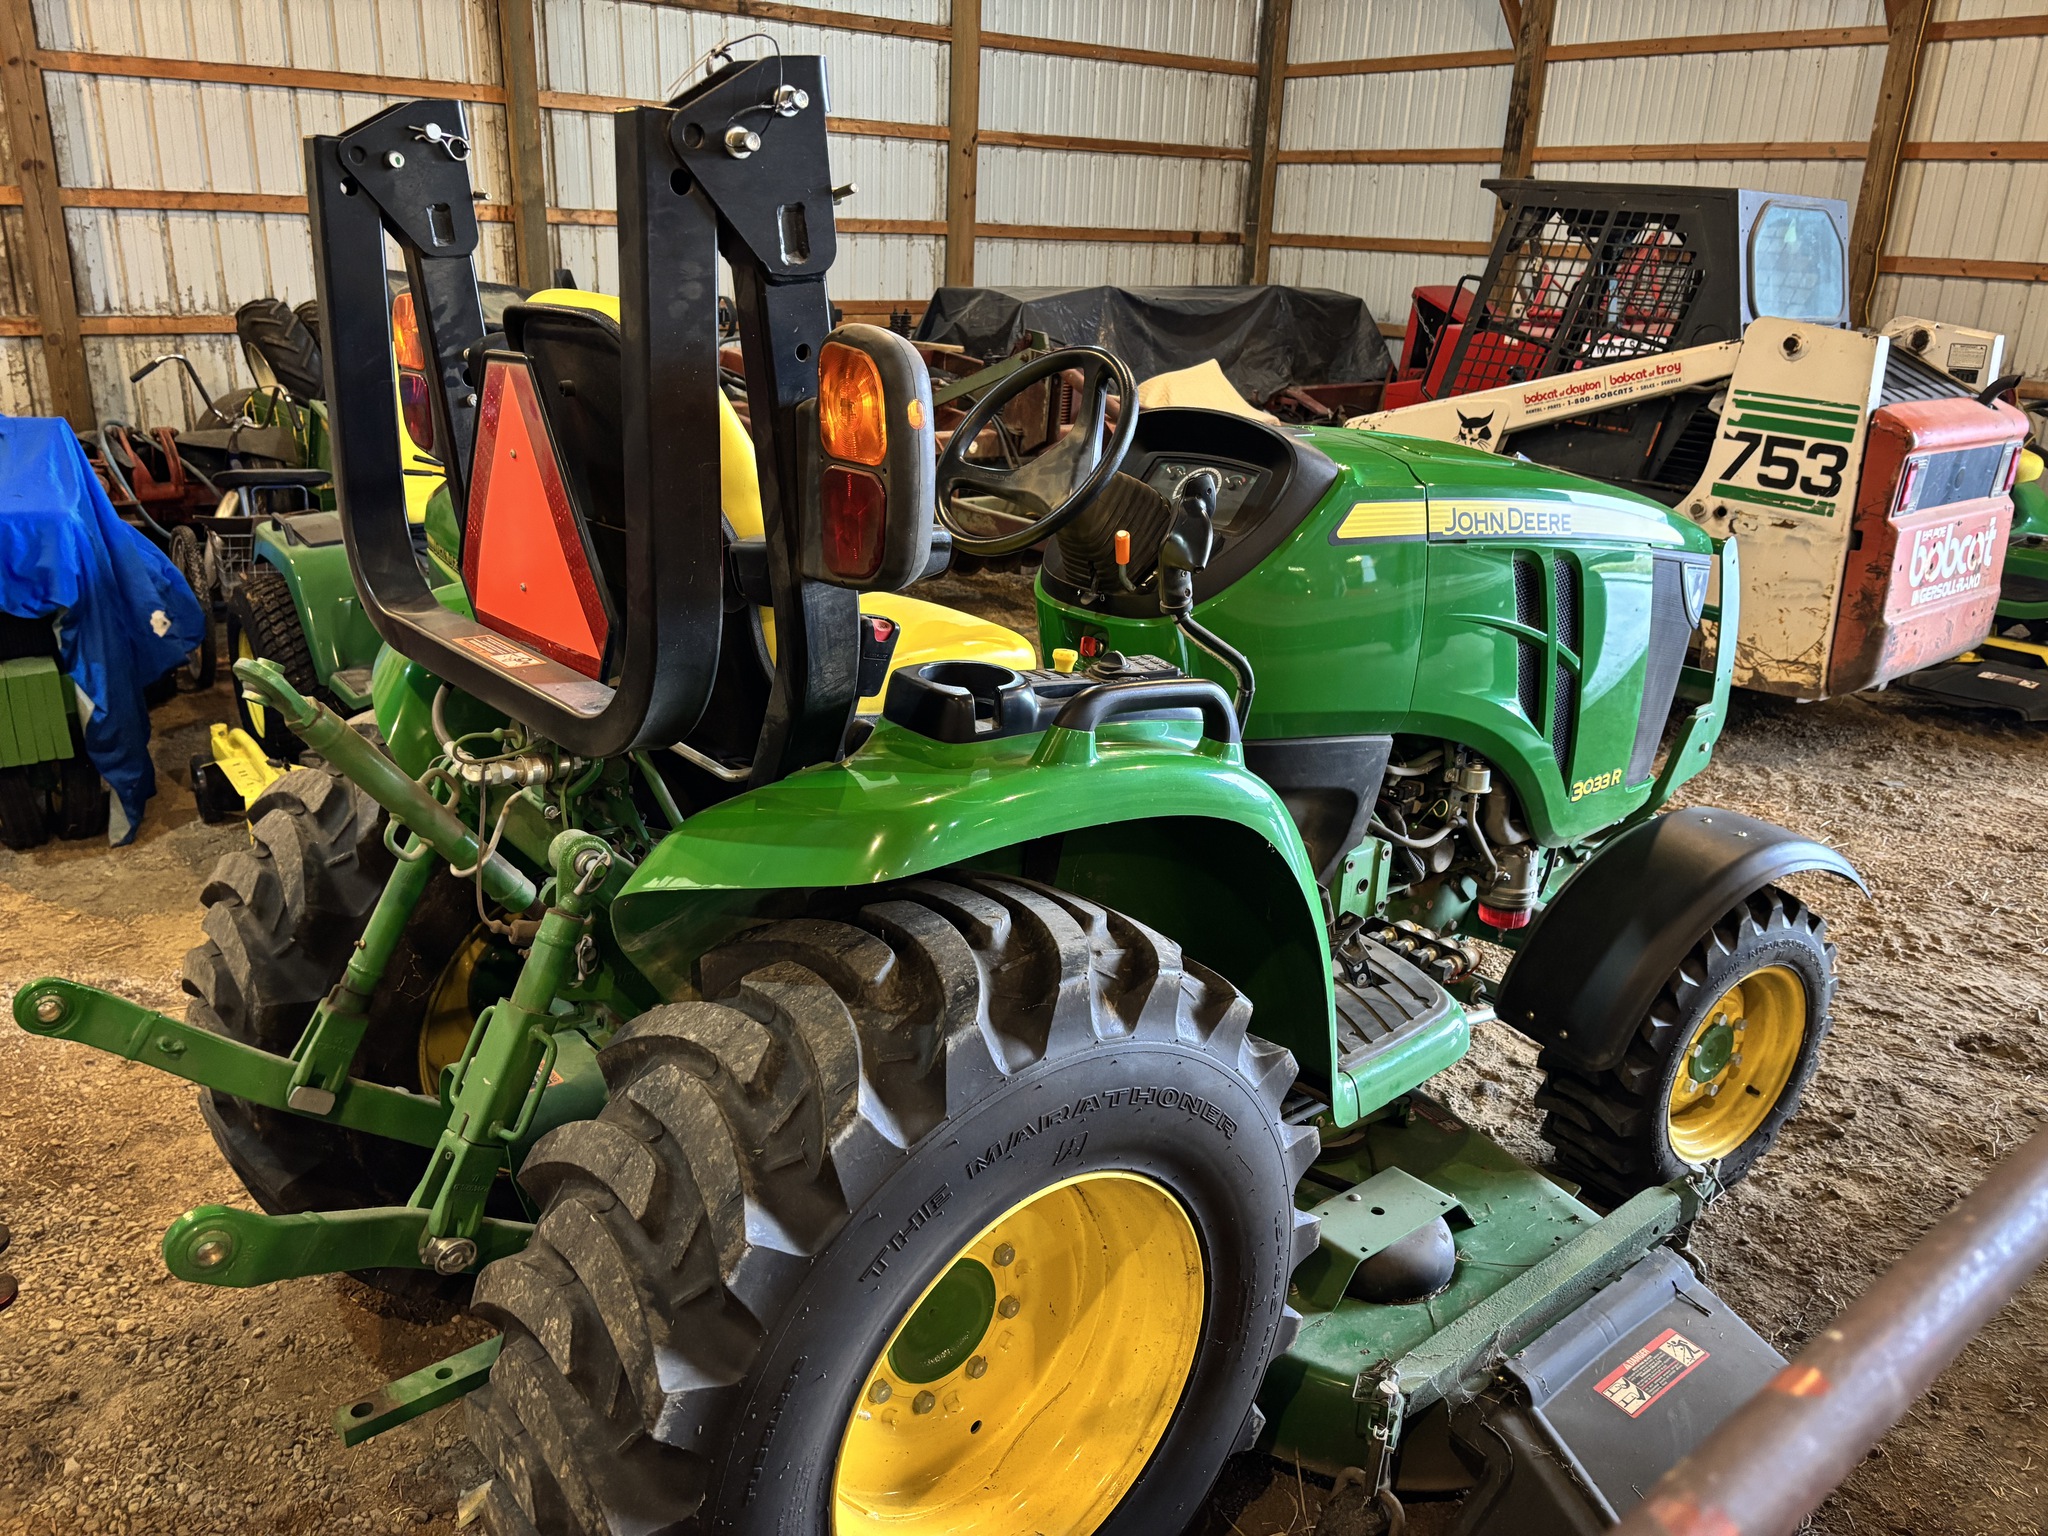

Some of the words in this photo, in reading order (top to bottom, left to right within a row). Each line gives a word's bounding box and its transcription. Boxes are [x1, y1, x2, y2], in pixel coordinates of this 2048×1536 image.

[1609, 371, 1647, 385] bobcat
[1656, 362, 1682, 375] troy
[1524, 389, 1557, 404] bobcat
[1565, 381, 1600, 396] dayton
[1567, 386, 1634, 406] 1-800-BOBCATS
[1640, 383, 1655, 391] SALES
[1660, 377, 1682, 387] SERVICE
[1718, 430, 1849, 498] 753
[1444, 507, 1504, 533] JOHN
[1508, 507, 1571, 533] DEERE
[1908, 516, 1997, 588] bobcat
[859, 1183, 953, 1282] THE
[965, 1086, 1238, 1180] MARATHONER
[1629, 1348, 1652, 1367] DANGER
